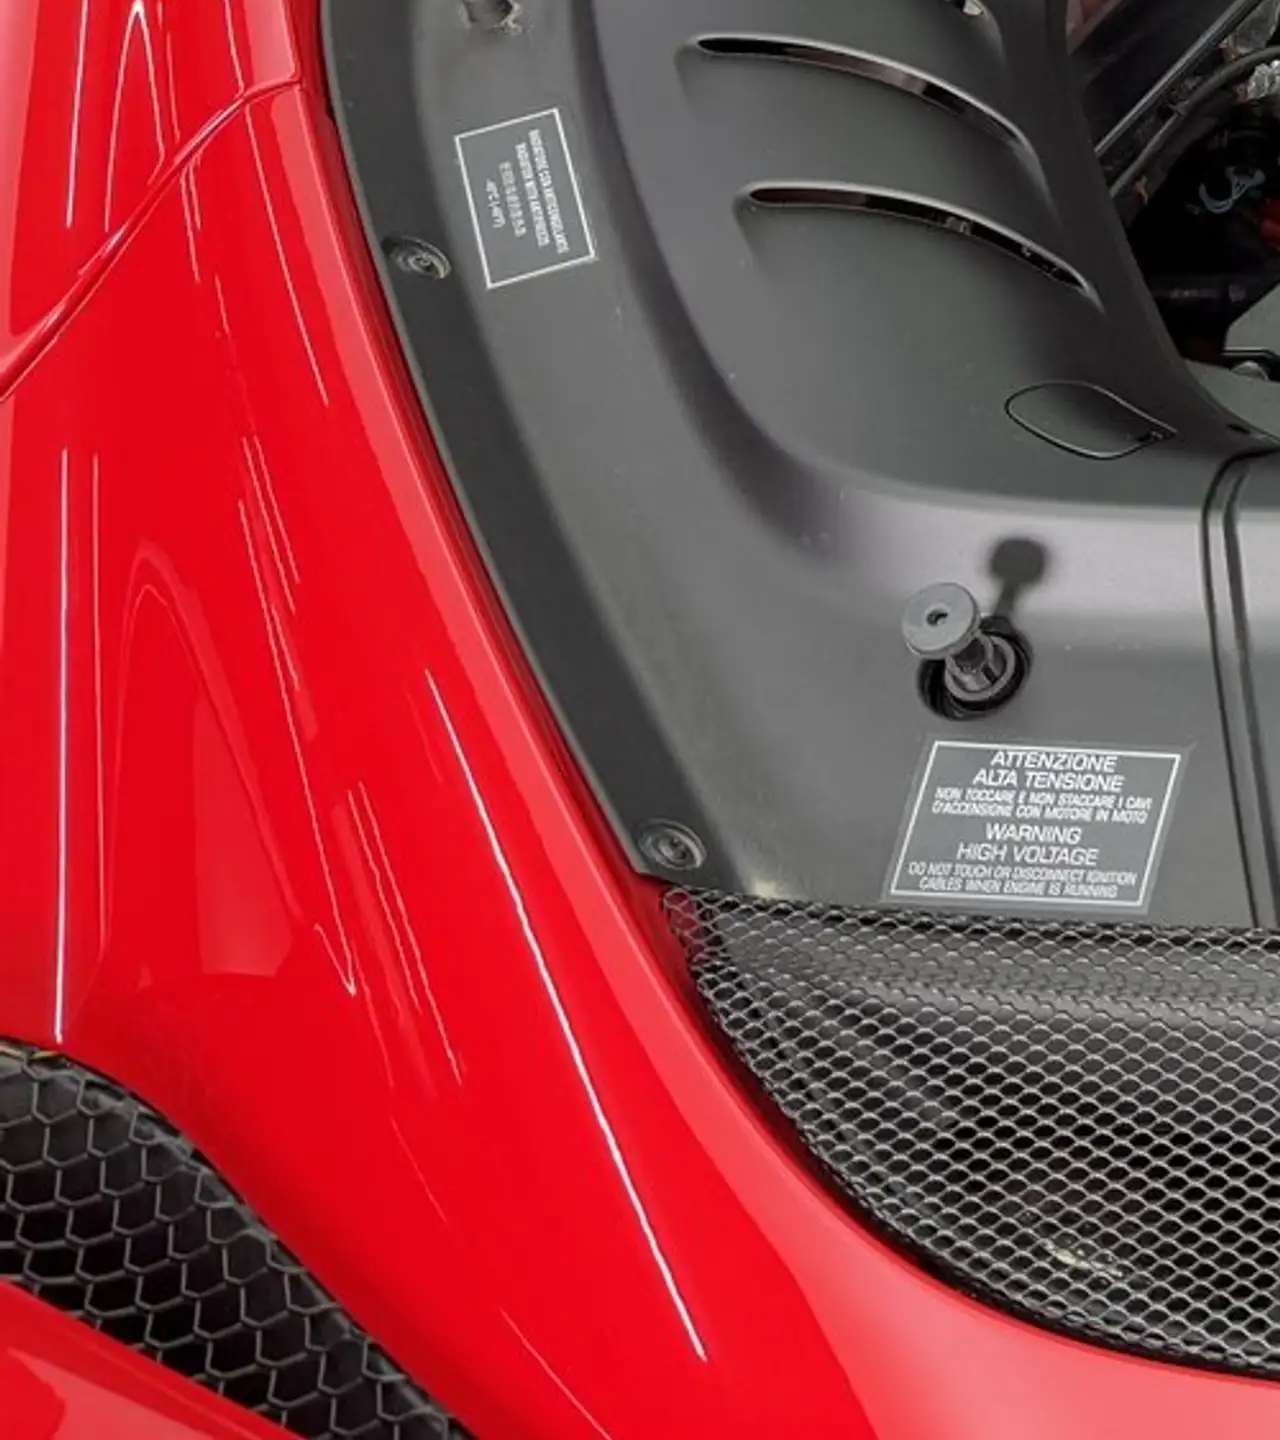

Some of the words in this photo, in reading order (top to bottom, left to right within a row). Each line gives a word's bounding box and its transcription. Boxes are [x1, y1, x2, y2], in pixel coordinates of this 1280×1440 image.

[990, 751, 1118, 773] ATTENZIONE
[972, 768, 1018, 787] ALTA
[1025, 771, 1125, 793] TENSIONE
[934, 786, 961, 800] NON
[964, 788, 1016, 804] TOCCARE
[1029, 791, 1055, 805] NON
[1057, 792, 1115, 808] STACCARE
[1015, 803, 1041, 819] CON
[1042, 805, 1094, 822] MOTORE
[1095, 809, 1109, 822] IN
[1111, 809, 1149, 825] MOTO
[986, 822, 1082, 845] WARNING
[956, 842, 1007, 860] HIGH
[1013, 844, 1099, 866] VOLTAGE
[908, 862, 926, 876] DO
[927, 863, 953, 877] NOT
[953, 864, 992, 879] TOUCH
[993, 866, 1011, 879] OR
[1012, 867, 1085, 883] DISCONNECT
[1087, 871, 1137, 886] IGNITION
[919, 877, 961, 891] CABLES
[963, 879, 1001, 893] WHEN
[1003, 881, 1046, 895] ENGINE
[1049, 883, 1062, 896] IS
[1063, 884, 1118, 898] RUNNING
